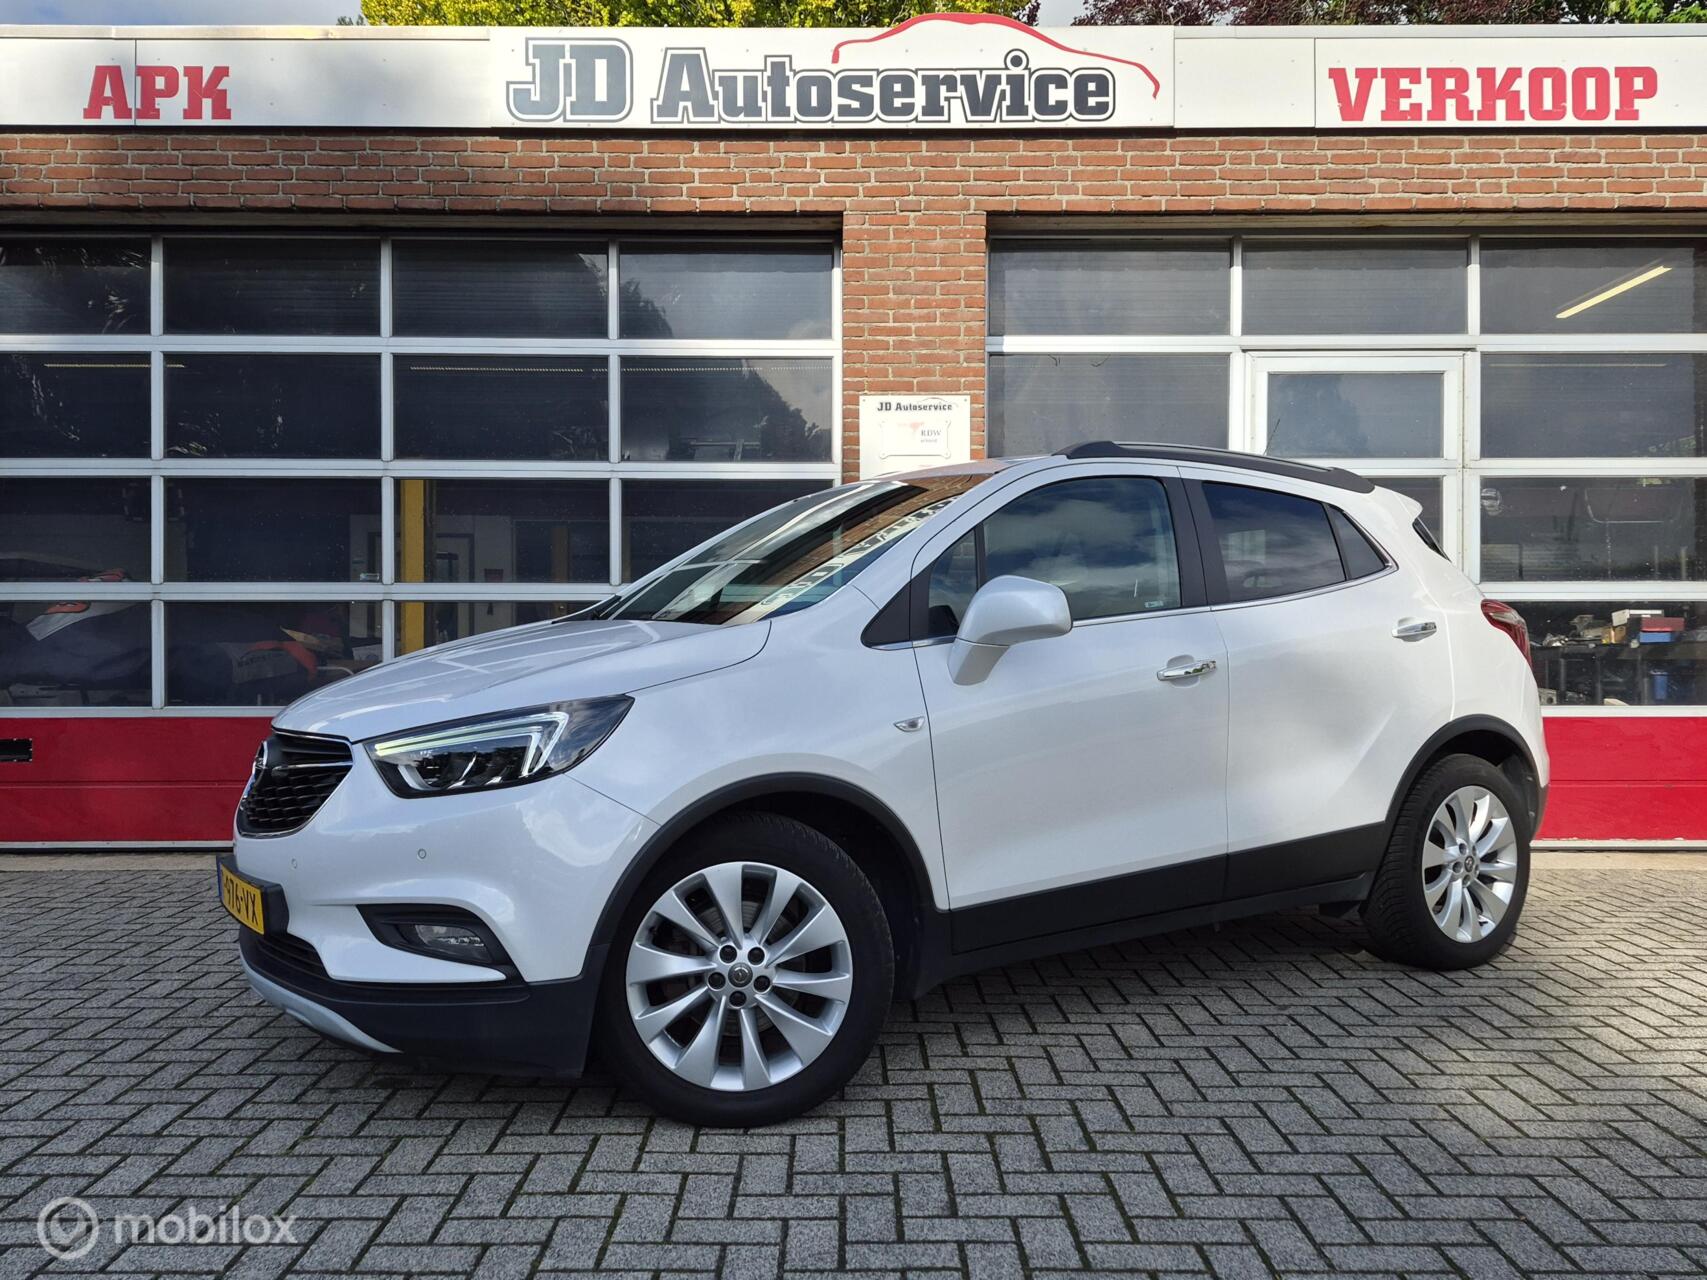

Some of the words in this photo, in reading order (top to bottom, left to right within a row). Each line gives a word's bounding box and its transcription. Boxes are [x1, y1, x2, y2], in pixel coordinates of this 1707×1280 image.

[83, 66, 231, 119] APK
[507, 39, 632, 121] JD
[650, 48, 1116, 123] Autoservice
[1328, 67, 1658, 121] VERKOOP
[877, 402, 891, 411] JD
[895, 402, 952, 411] Autoservice
[921, 429, 941, 437] RDW
